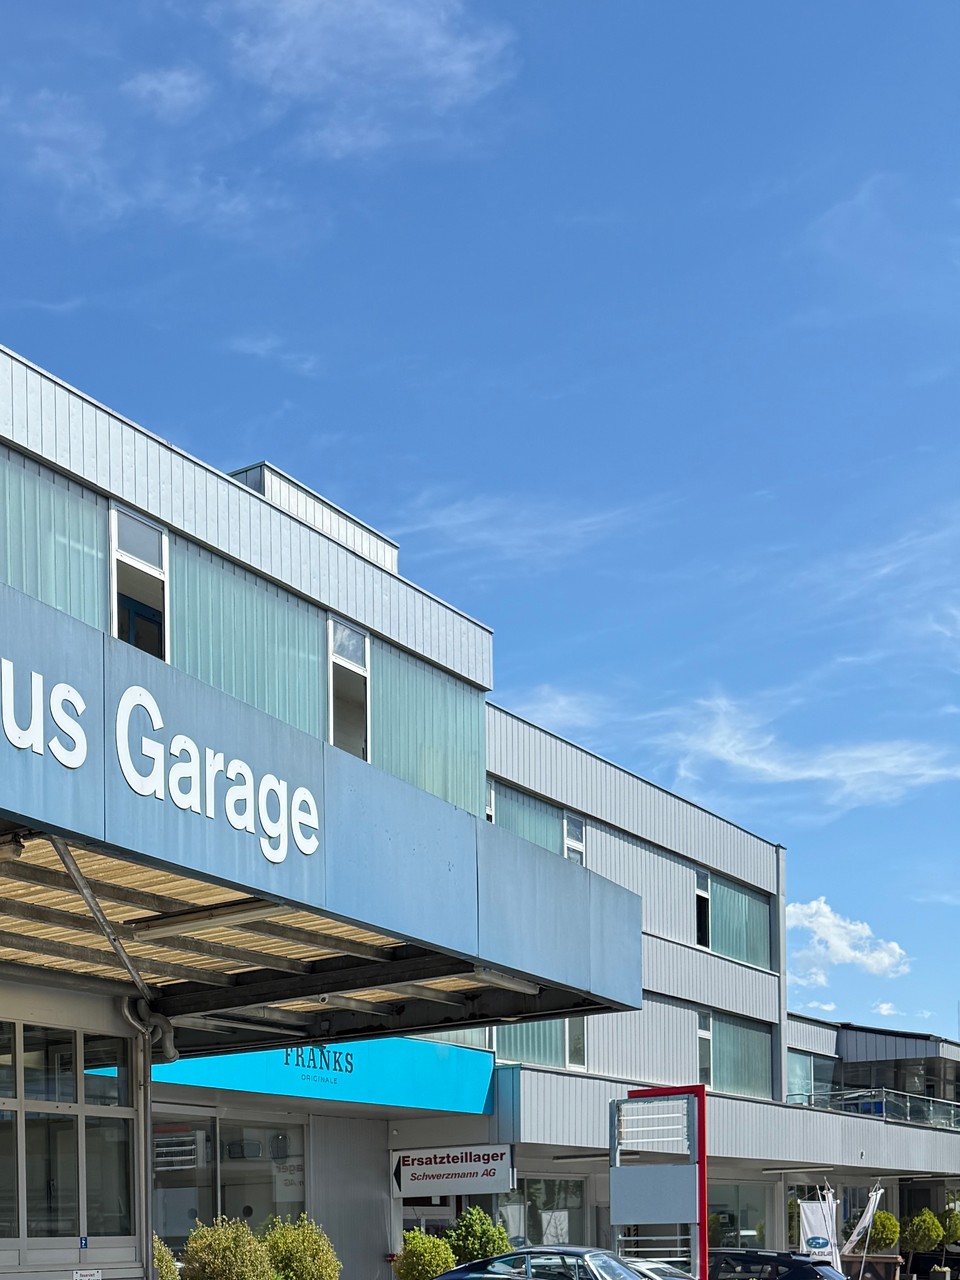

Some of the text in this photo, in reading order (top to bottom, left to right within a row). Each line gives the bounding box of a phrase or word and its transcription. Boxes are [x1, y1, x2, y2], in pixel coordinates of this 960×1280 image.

[114, 684, 320, 864] Garage
[284, 1047, 353, 1074] FRANKS
[301, 1073, 338, 1085] ORIGINALE
[401, 1151, 506, 1167] Ersatzteillager
[410, 1168, 497, 1181] Schwerzmann AG
